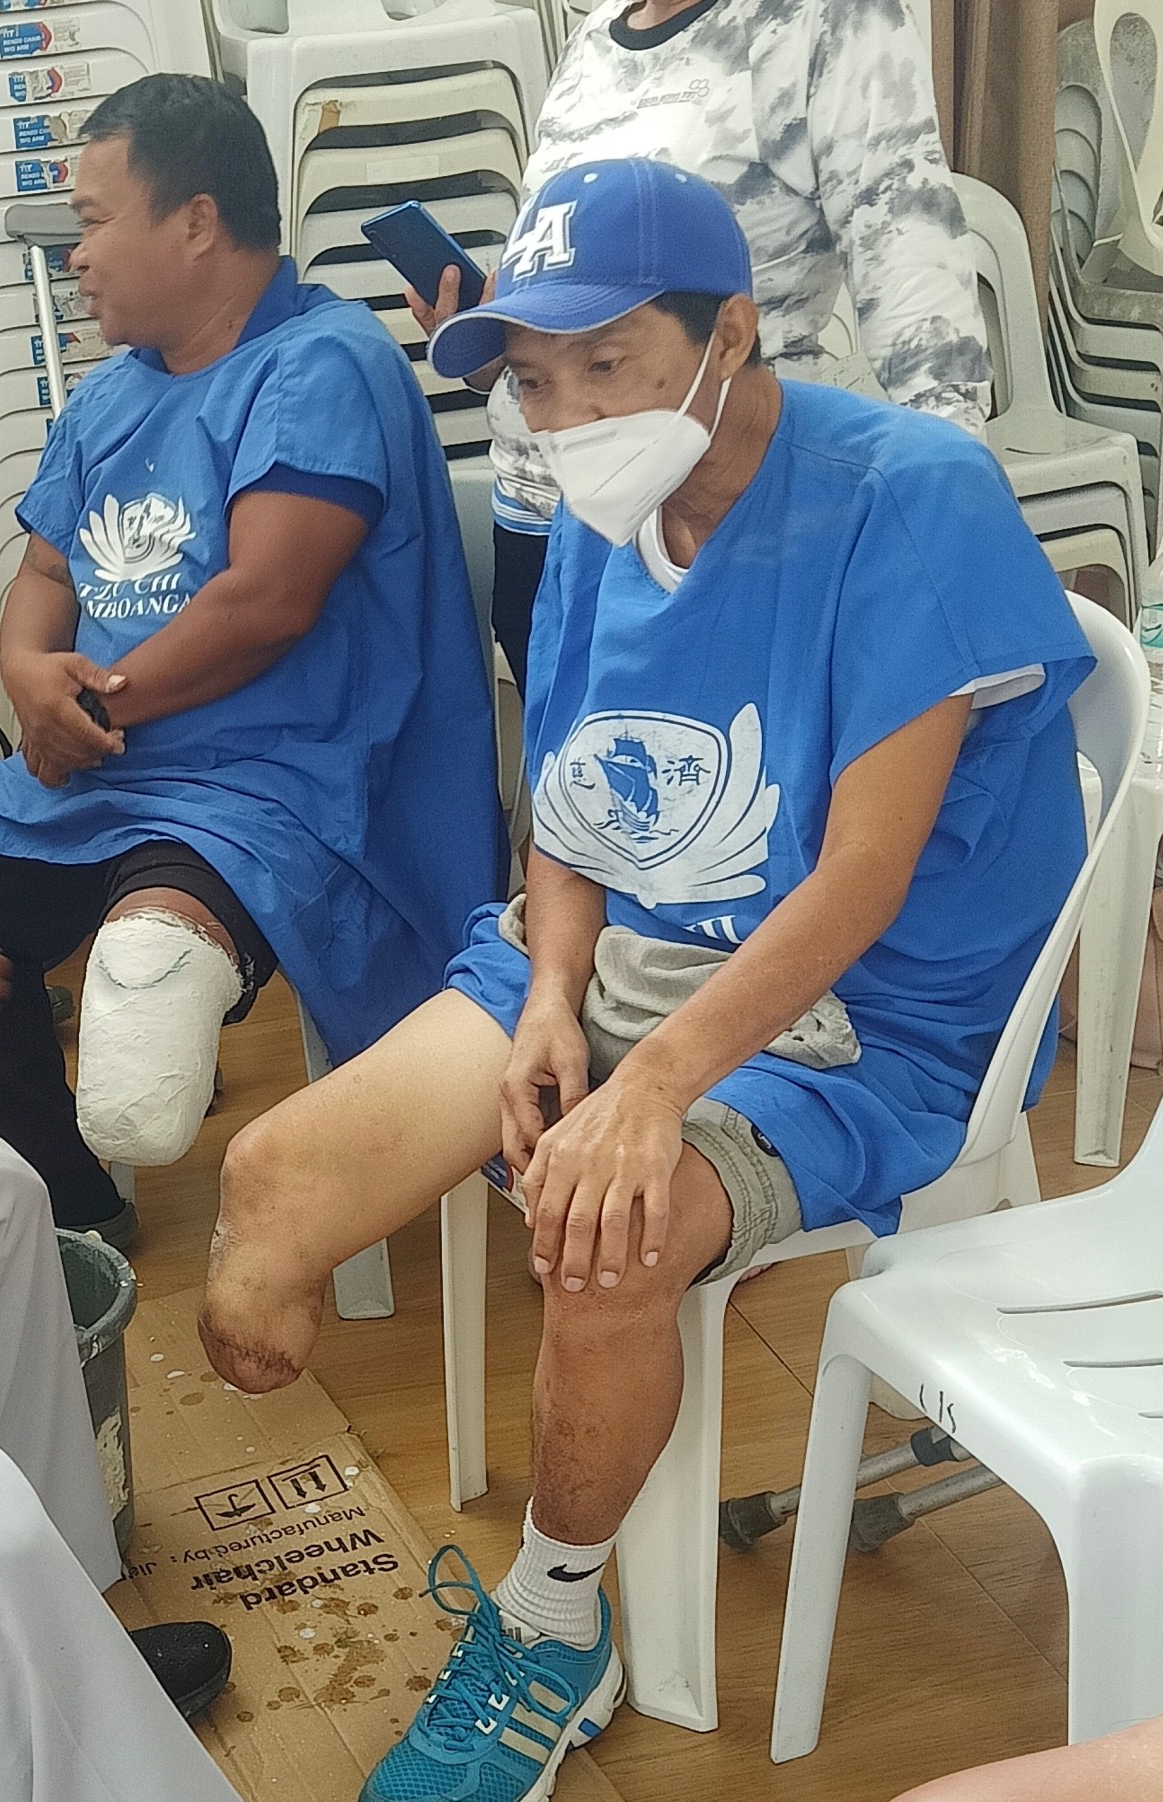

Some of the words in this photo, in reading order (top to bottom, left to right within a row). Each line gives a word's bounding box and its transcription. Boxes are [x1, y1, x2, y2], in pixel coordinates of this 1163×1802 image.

[134, 572, 182, 595] CHI
[217, 1506, 366, 1552] Manufactured
[191, 1528, 385, 1591] Wheelchair
[239, 1553, 399, 1611] Standard
